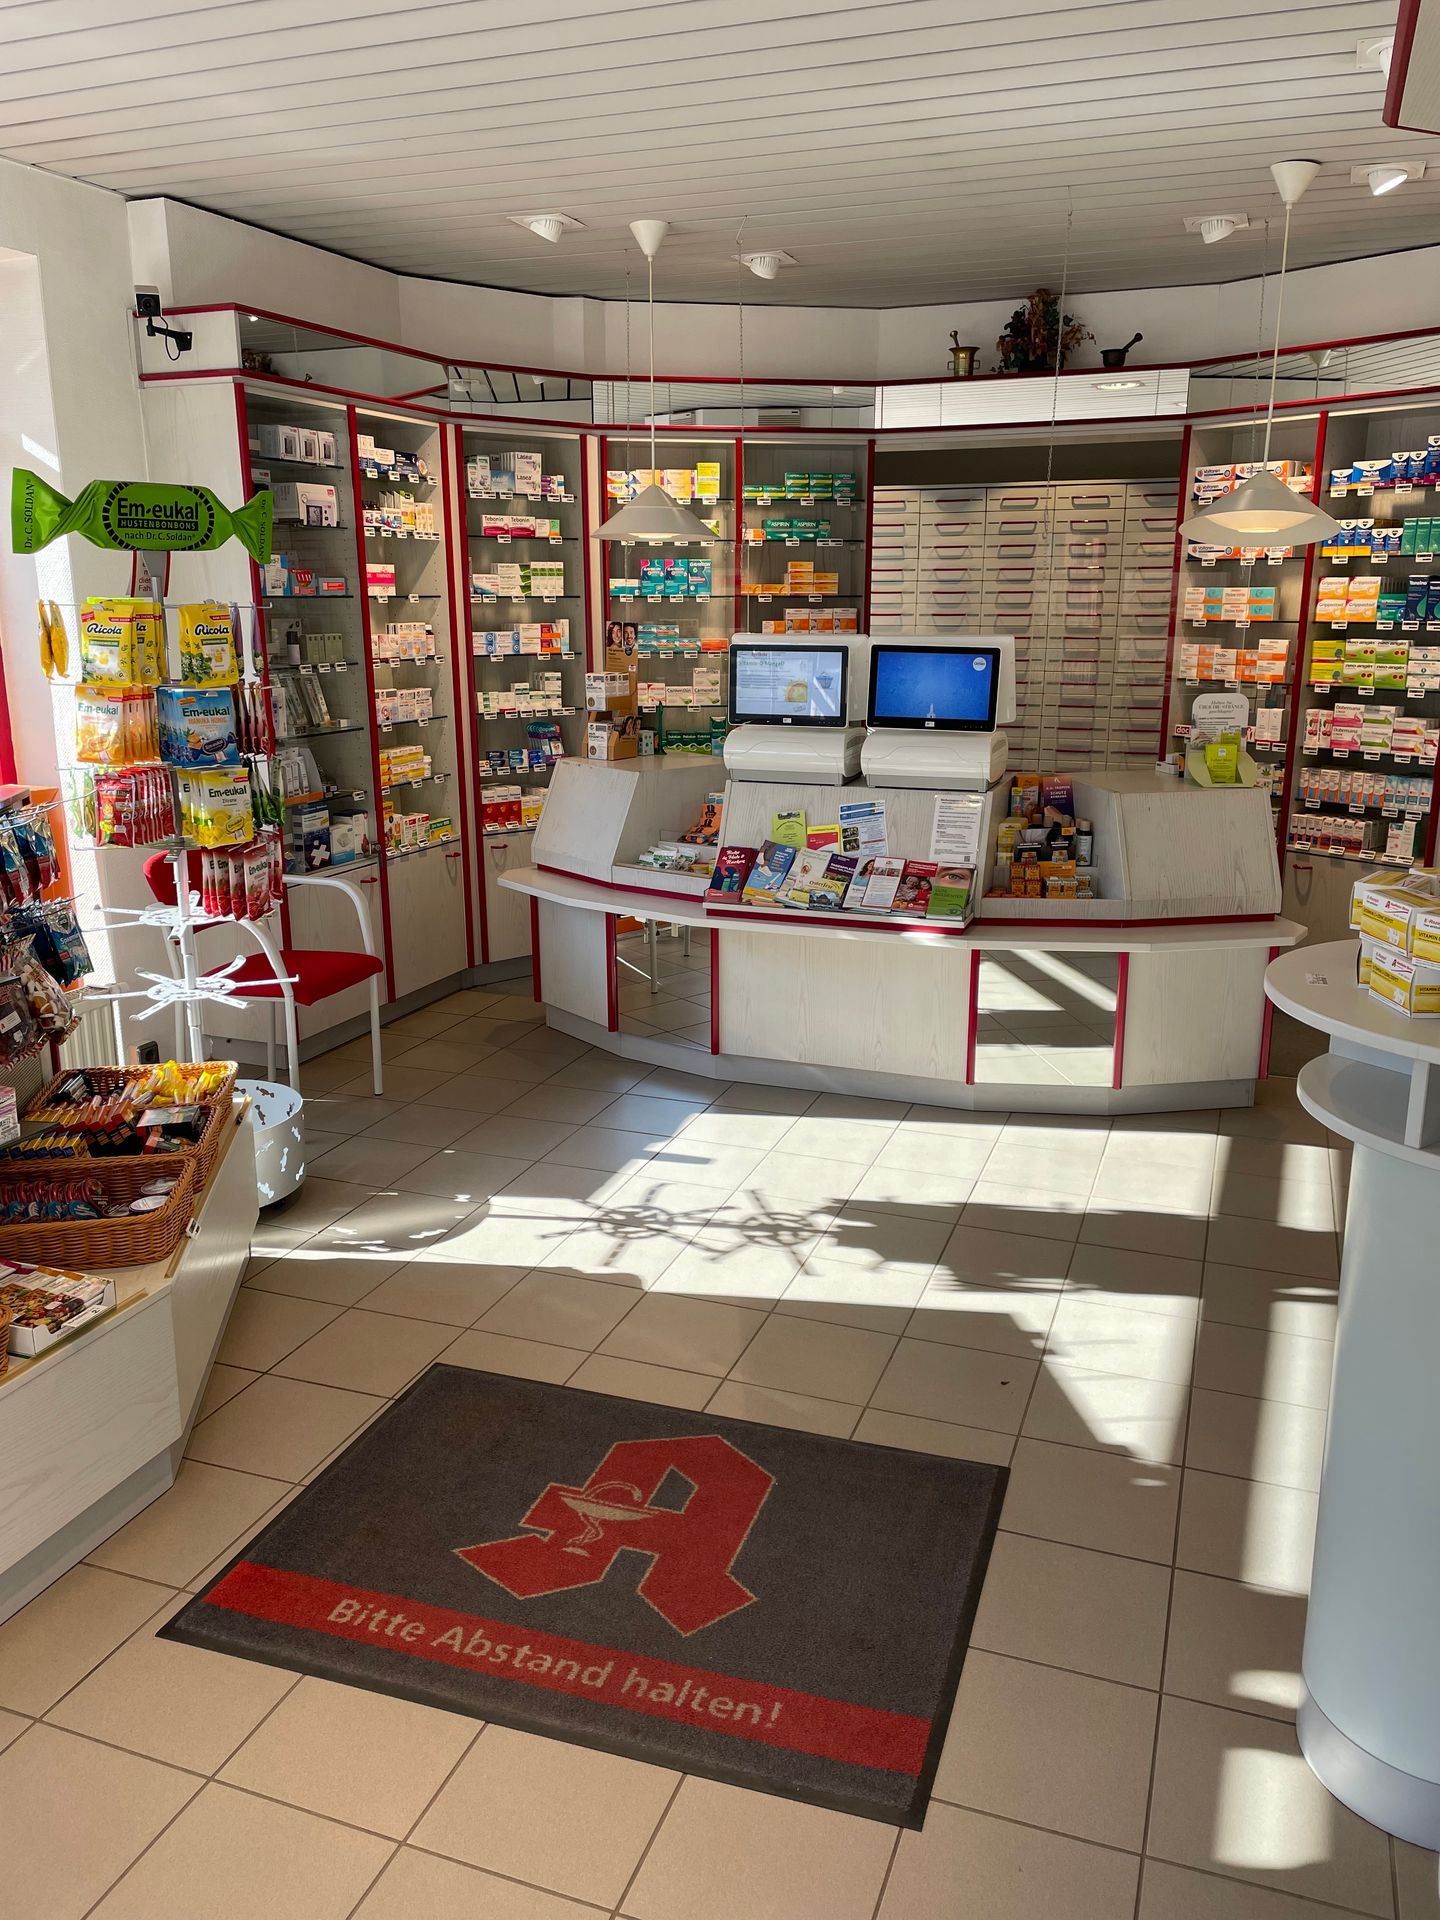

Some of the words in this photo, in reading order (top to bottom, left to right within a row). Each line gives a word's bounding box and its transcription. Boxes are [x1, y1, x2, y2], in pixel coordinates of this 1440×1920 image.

[121, 520, 196, 530] HUSTENBONBONS
[124, 531, 144, 540] nach
[87, 623, 122, 635] Ricola
[194, 623, 230, 636] Ricola
[78, 702, 119, 716] Em-eukal
[182, 706, 230, 717] Em-eukal
[1176, 726, 1190, 734] doc
[208, 786, 248, 798] Em-eukal
[327, 1598, 426, 1642] Bitte
[431, 1624, 615, 1690] Abstand
[621, 1666, 784, 1729] halten!
